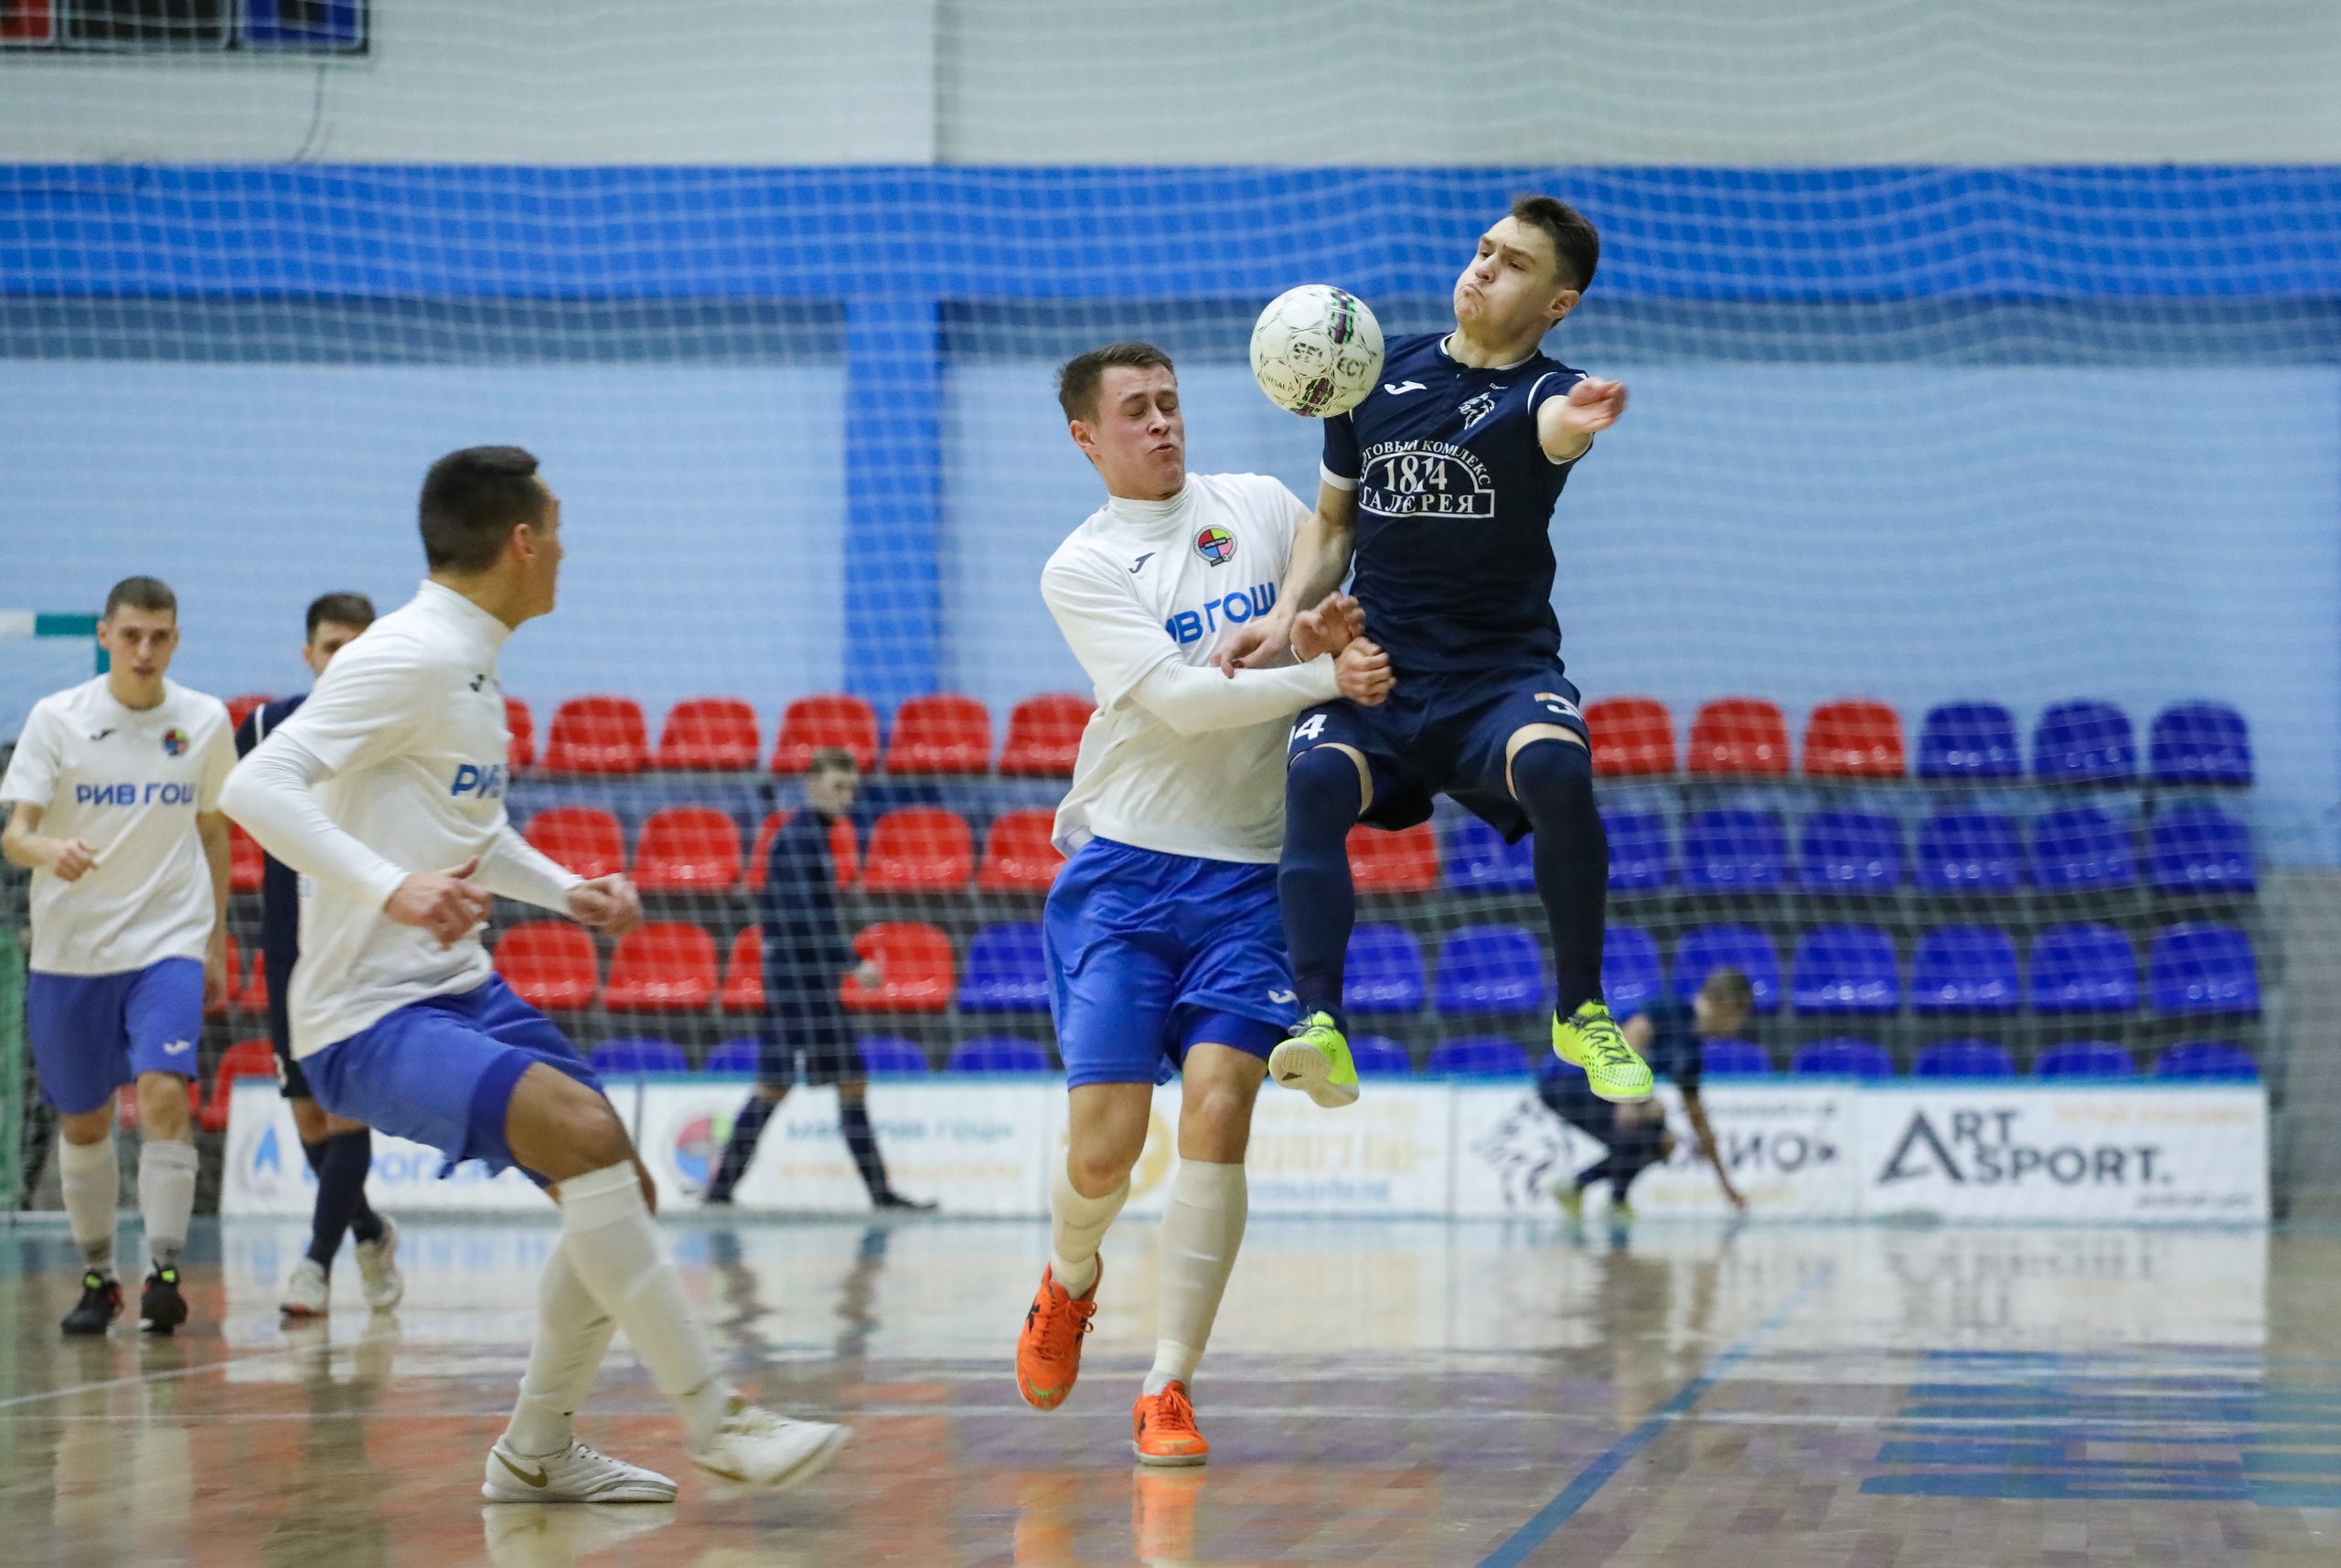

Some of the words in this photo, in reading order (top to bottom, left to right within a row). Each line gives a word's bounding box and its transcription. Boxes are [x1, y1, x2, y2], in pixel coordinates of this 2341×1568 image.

[1383, 454, 1448, 495] 1814
[1362, 485, 1476, 514] ГАЛЕРЕЯ
[1203, 581, 1277, 634] ГОШ
[76, 783, 136, 805] РИВ
